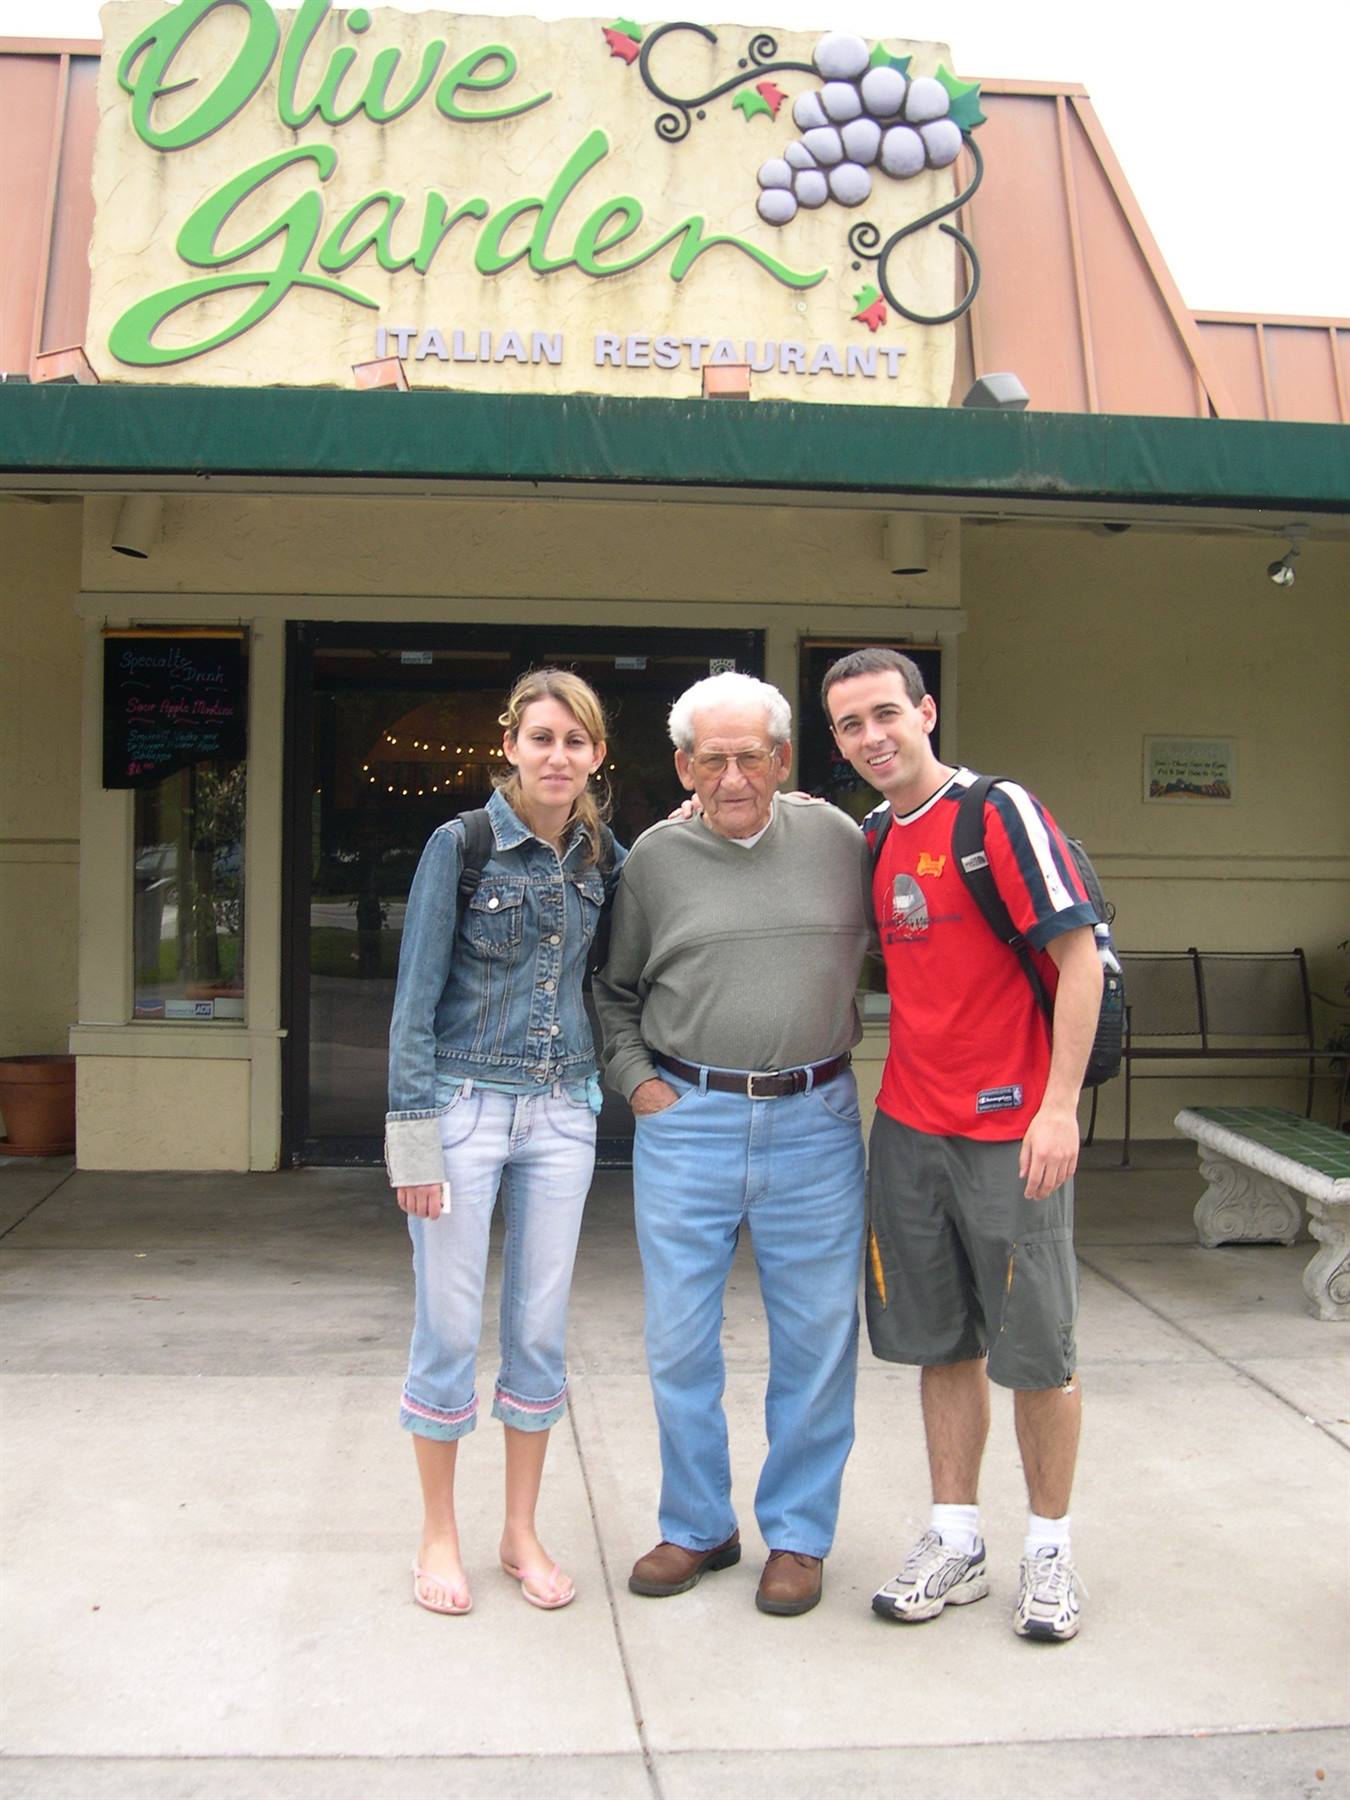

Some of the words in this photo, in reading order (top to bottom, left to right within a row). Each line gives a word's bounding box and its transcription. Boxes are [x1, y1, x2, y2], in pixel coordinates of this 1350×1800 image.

[117, 0, 554, 152] Olive
[376, 327, 563, 364] ITALIAN
[594, 334, 906, 378] RESTAURANT
[119, 647, 193, 678] Specialty
